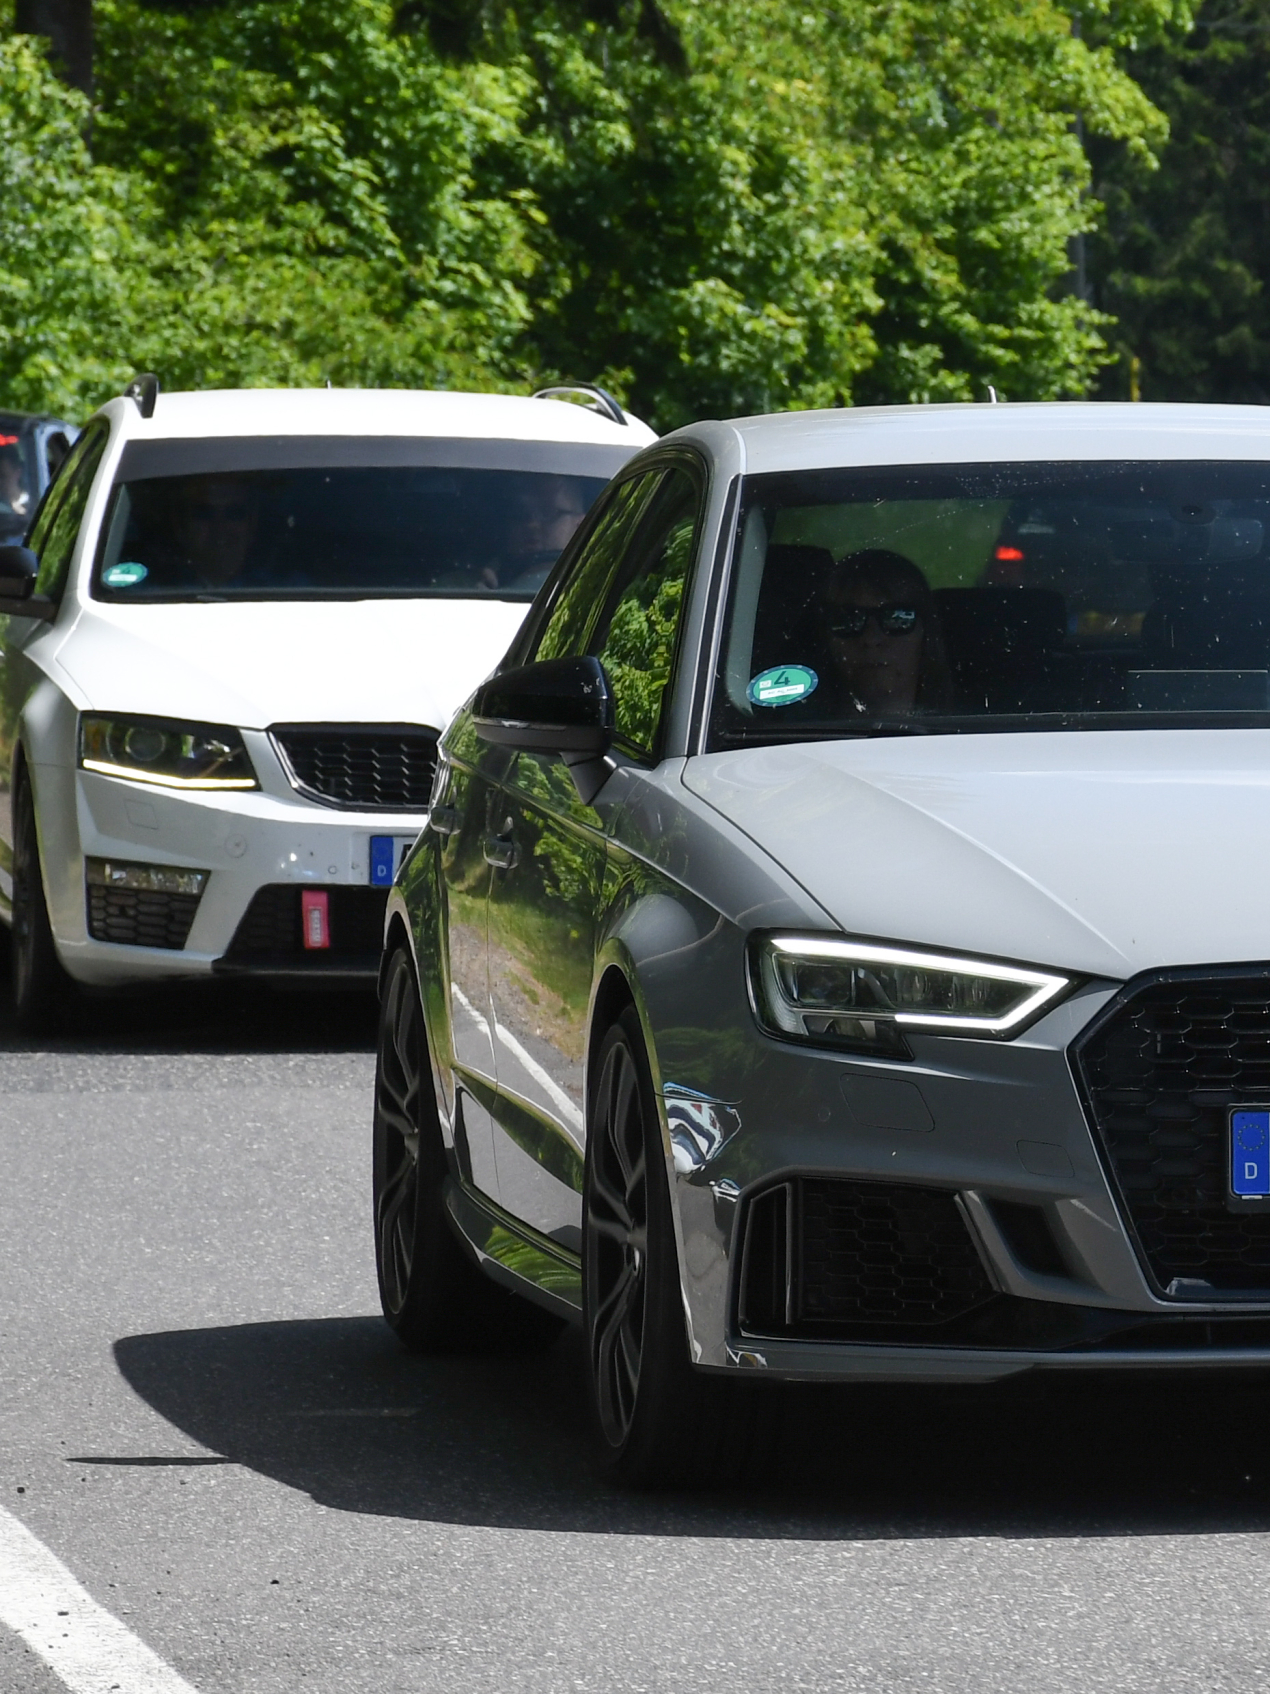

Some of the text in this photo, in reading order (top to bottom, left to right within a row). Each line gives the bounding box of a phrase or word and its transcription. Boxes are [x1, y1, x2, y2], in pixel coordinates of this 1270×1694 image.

[775, 671, 790, 685] 4
[378, 865, 387, 877] D
[1244, 1162, 1258, 1180] D
